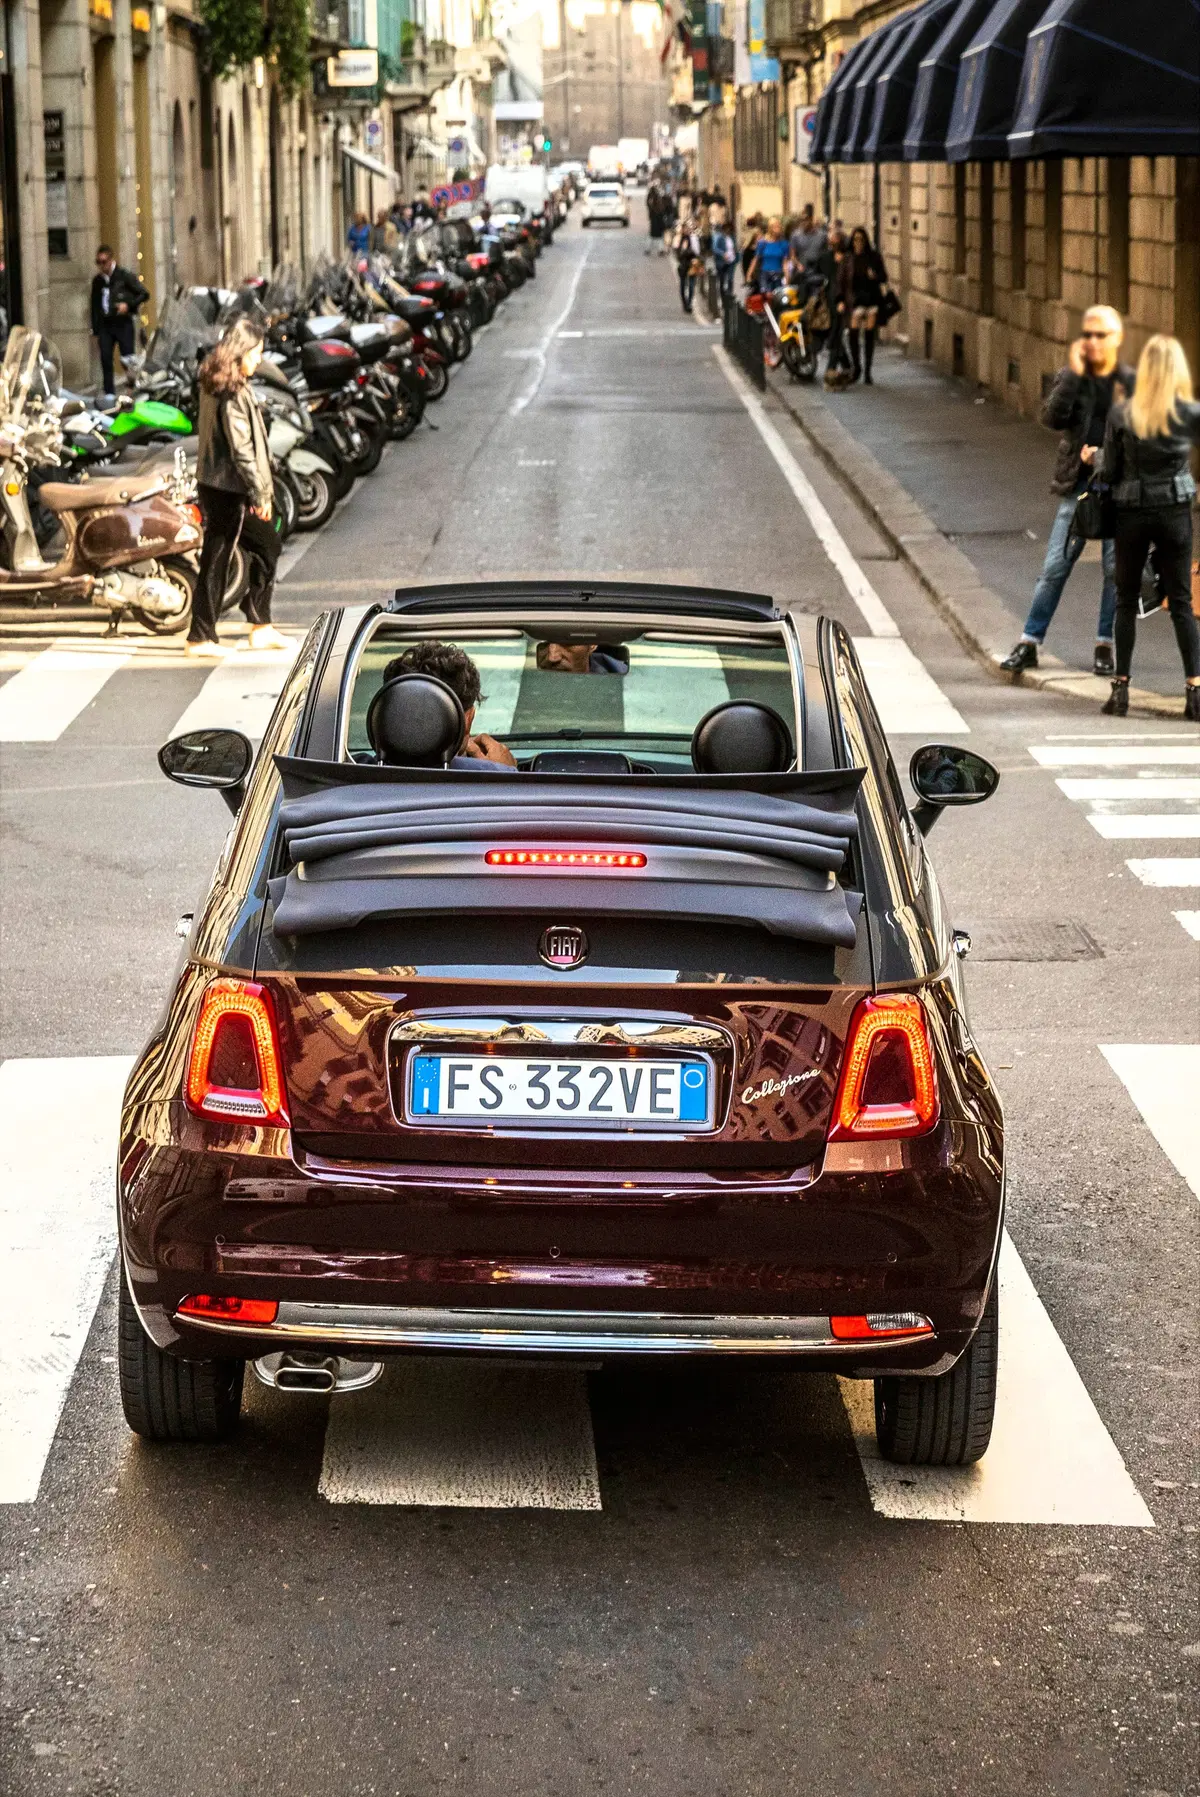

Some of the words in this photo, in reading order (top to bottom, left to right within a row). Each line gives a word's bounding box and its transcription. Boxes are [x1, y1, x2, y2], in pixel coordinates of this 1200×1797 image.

[550, 936, 580, 957] FIAT
[423, 1087, 430, 1109] I
[447, 1064, 504, 1110] FS
[526, 1064, 675, 1114] 332VE
[741, 1068, 821, 1105] Collezione
